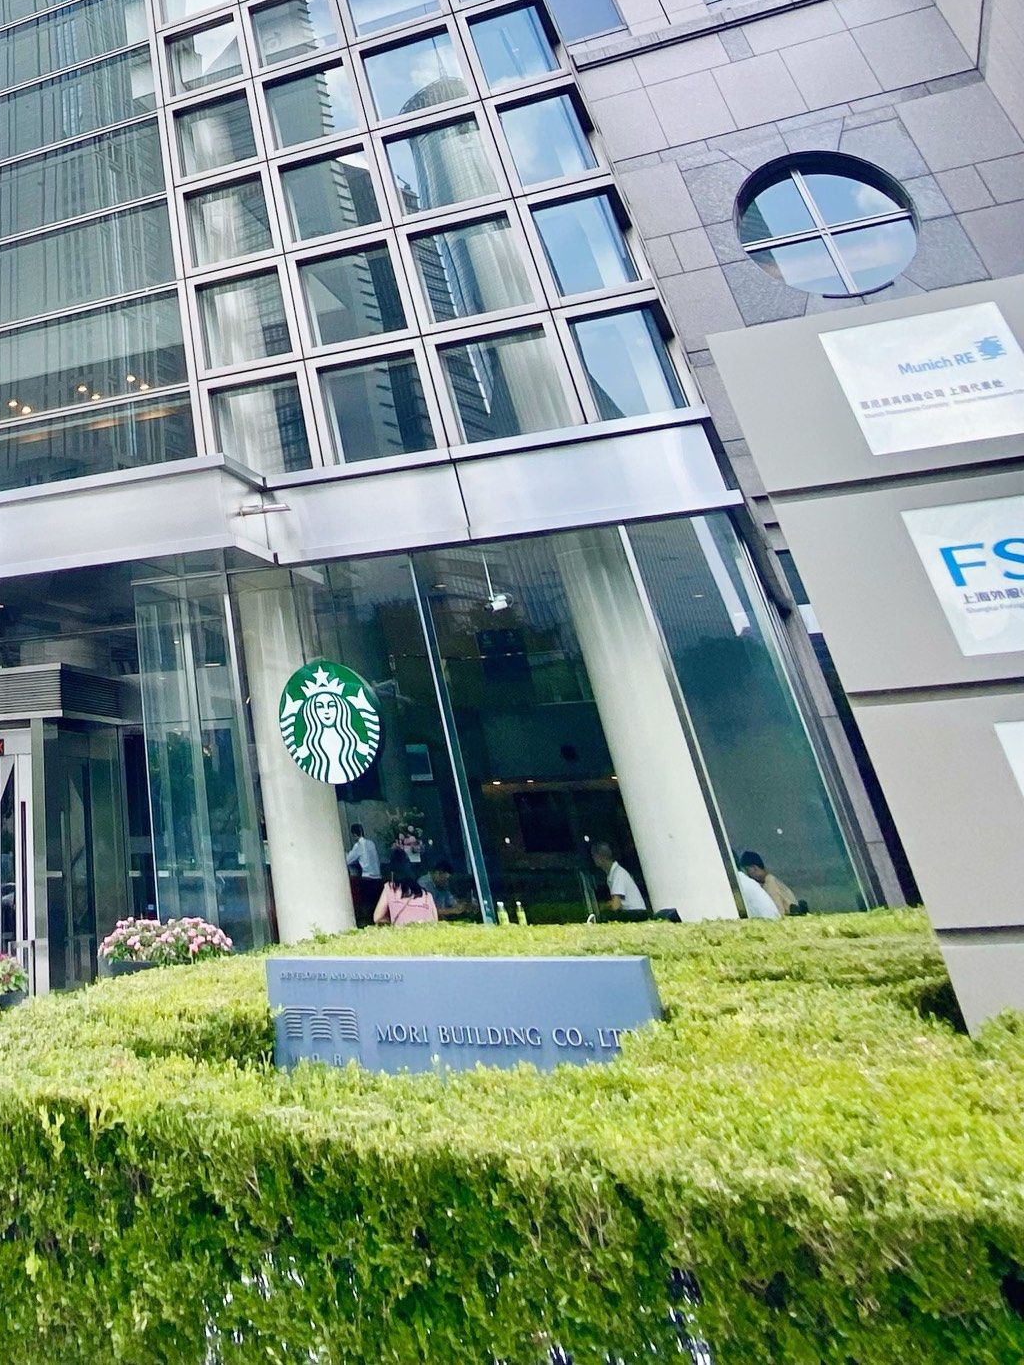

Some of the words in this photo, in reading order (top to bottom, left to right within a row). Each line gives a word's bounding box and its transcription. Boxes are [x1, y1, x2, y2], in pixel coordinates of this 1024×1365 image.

[897, 356, 953, 376] Munich
[954, 351, 977, 367] RE
[375, 1023, 430, 1044] MORI
[437, 1025, 543, 1047] BUILDING
